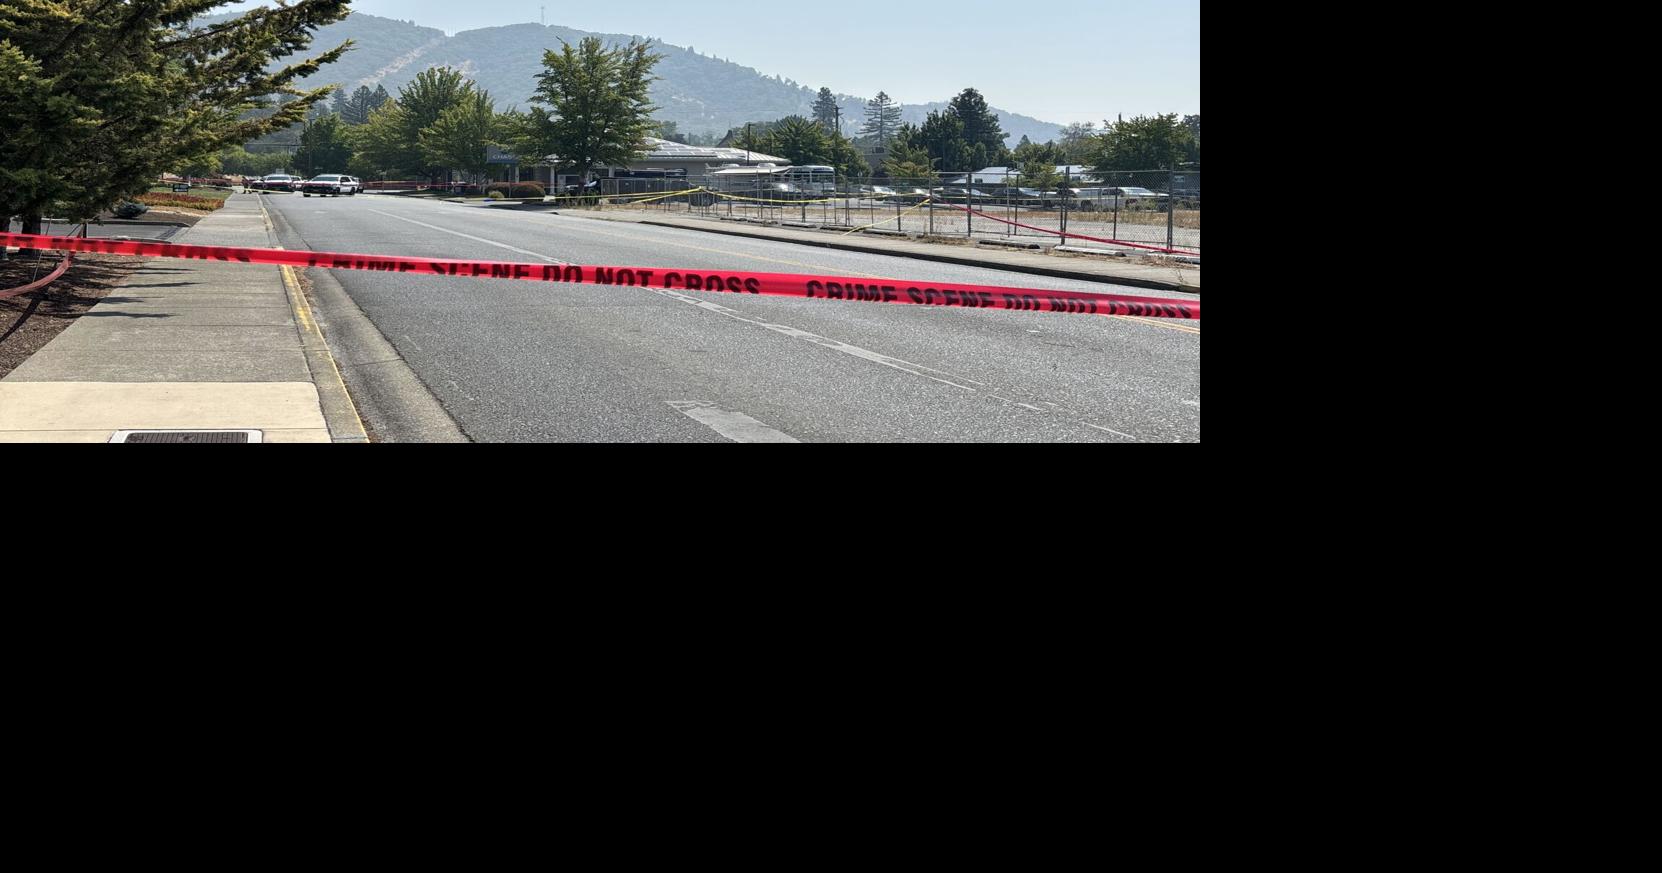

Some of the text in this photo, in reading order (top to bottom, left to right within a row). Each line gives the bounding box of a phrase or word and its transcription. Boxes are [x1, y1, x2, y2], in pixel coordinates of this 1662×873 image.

[542, 265, 583, 283] DO
[595, 267, 653, 287] NOT
[664, 272, 760, 294] CROSS
[806, 280, 898, 302] CRIME
[907, 286, 995, 308] SCENE
